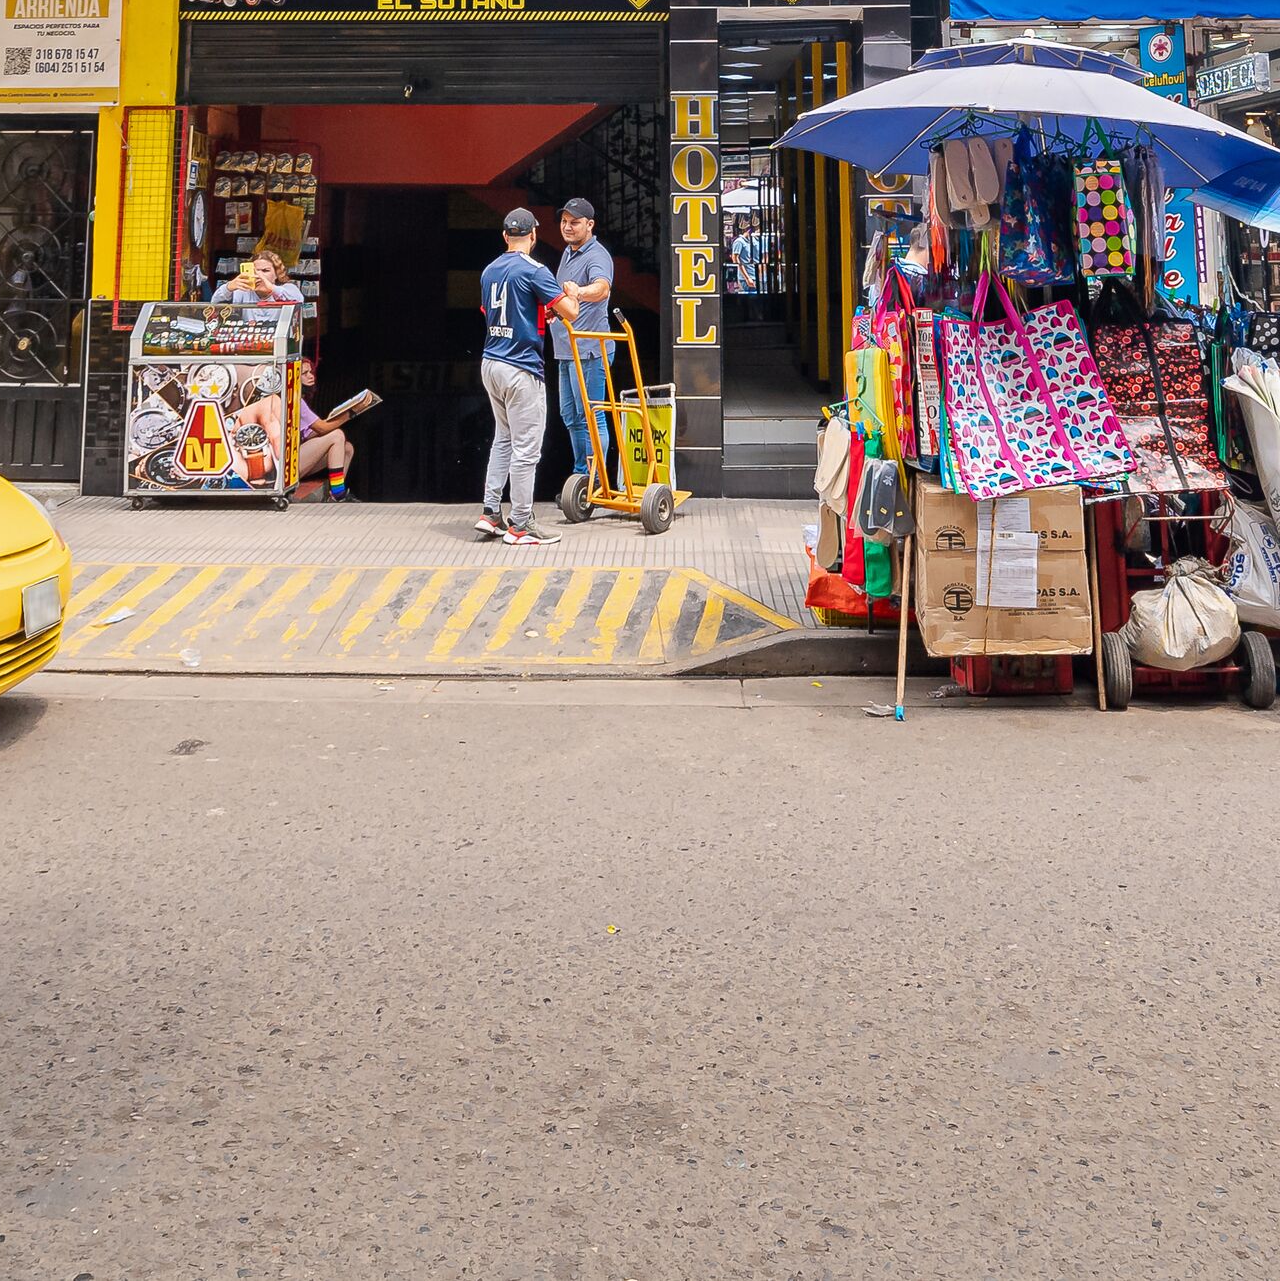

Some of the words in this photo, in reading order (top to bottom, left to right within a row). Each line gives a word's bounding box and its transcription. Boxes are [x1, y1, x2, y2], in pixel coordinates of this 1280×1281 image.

[35, 49, 54, 60] 318
[55, 49, 72, 60] 678
[75, 48, 85, 59] 15
[86, 48, 99, 60] 47
[670, 92, 719, 345] HOTEL
[491, 281, 508, 326] 4
[629, 428, 643, 444] NO
[633, 446, 663, 464] CUO
